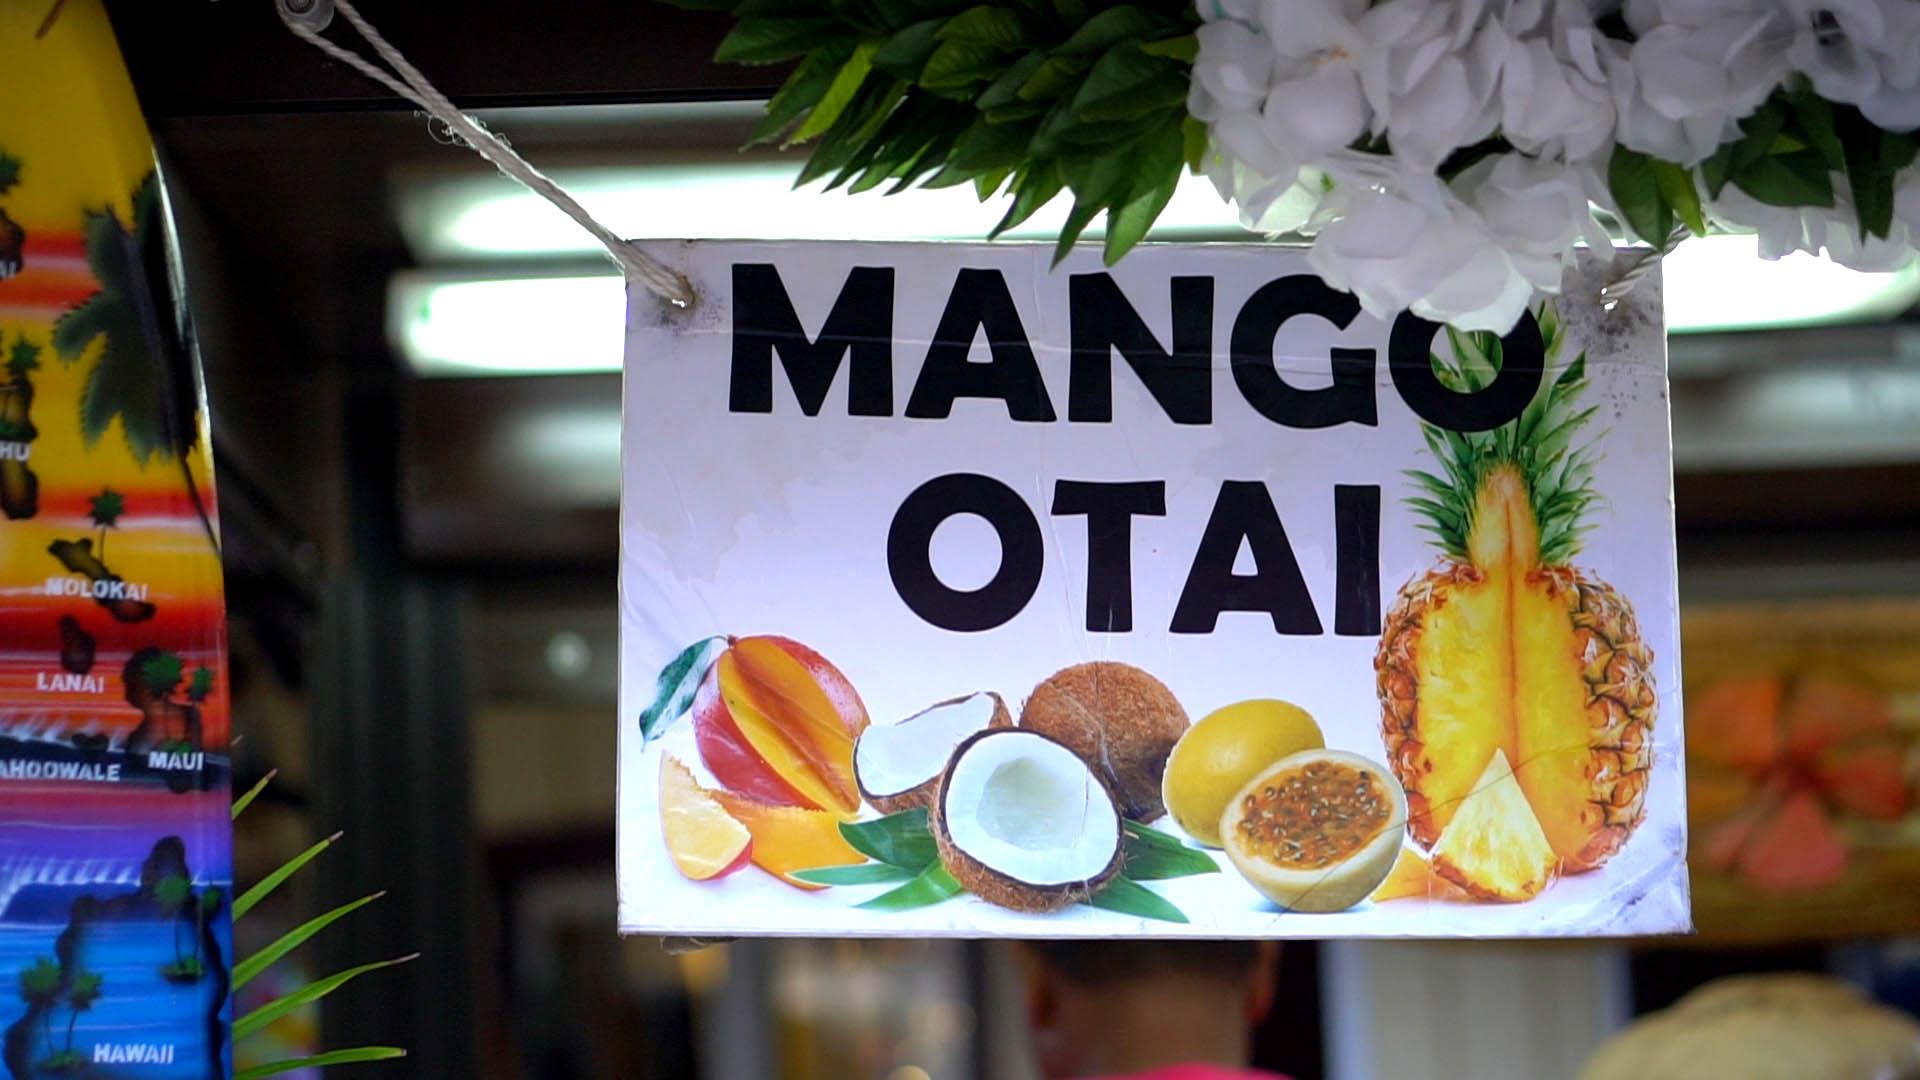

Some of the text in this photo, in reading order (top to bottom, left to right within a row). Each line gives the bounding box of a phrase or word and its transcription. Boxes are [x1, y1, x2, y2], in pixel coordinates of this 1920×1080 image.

[729, 263, 1545, 432] MANGO
[887, 472, 1382, 636] OTAI
[45, 577, 149, 601] MOLOKAI
[37, 672, 104, 693] LANAI
[149, 751, 203, 771] MAUI
[93, 1043, 174, 1065] HAWAII
